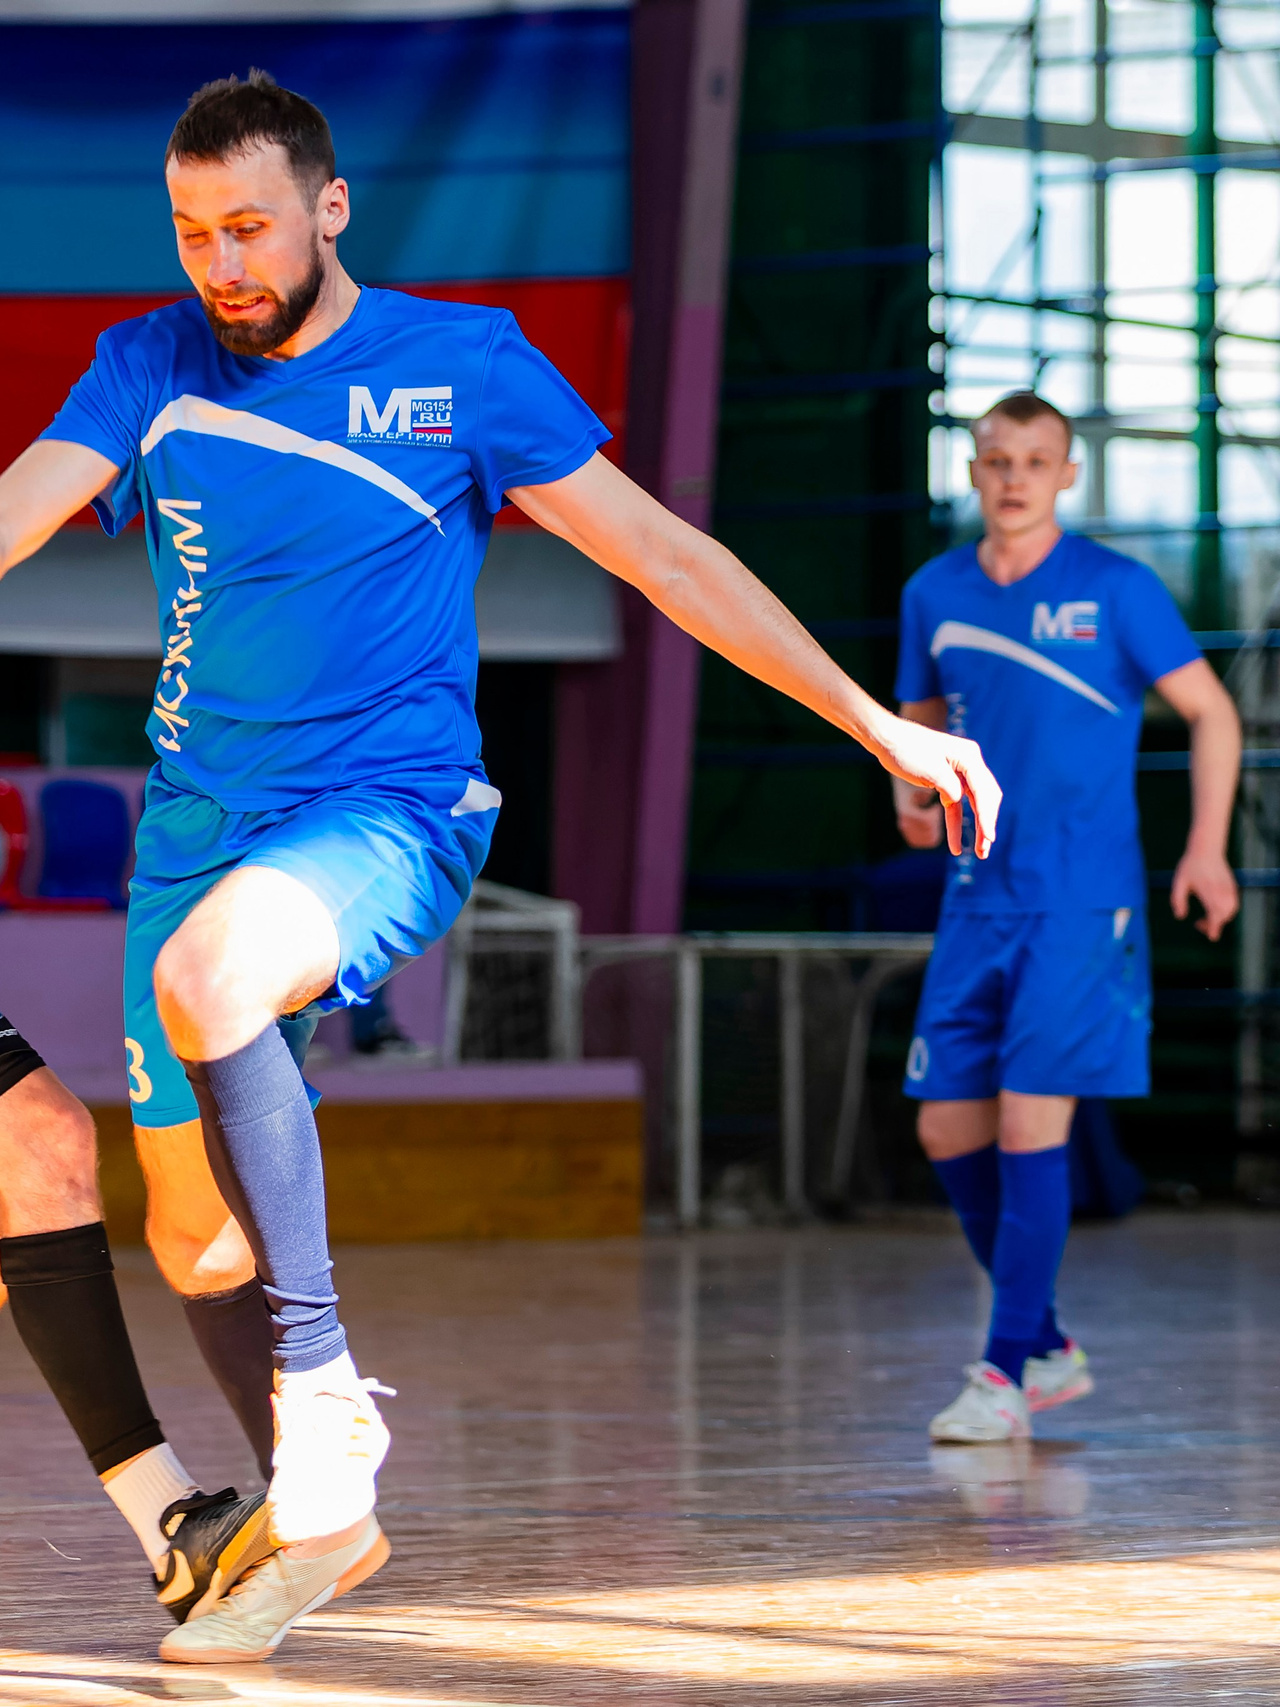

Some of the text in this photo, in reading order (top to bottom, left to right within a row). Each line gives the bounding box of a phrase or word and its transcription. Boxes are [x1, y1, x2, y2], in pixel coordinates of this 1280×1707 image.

[412, 401, 453, 412] MG154
[413, 412, 451, 422] .RU
[347, 431, 452, 444] МАСТЕР ГРУПП
[124, 1037, 153, 1103] 3
